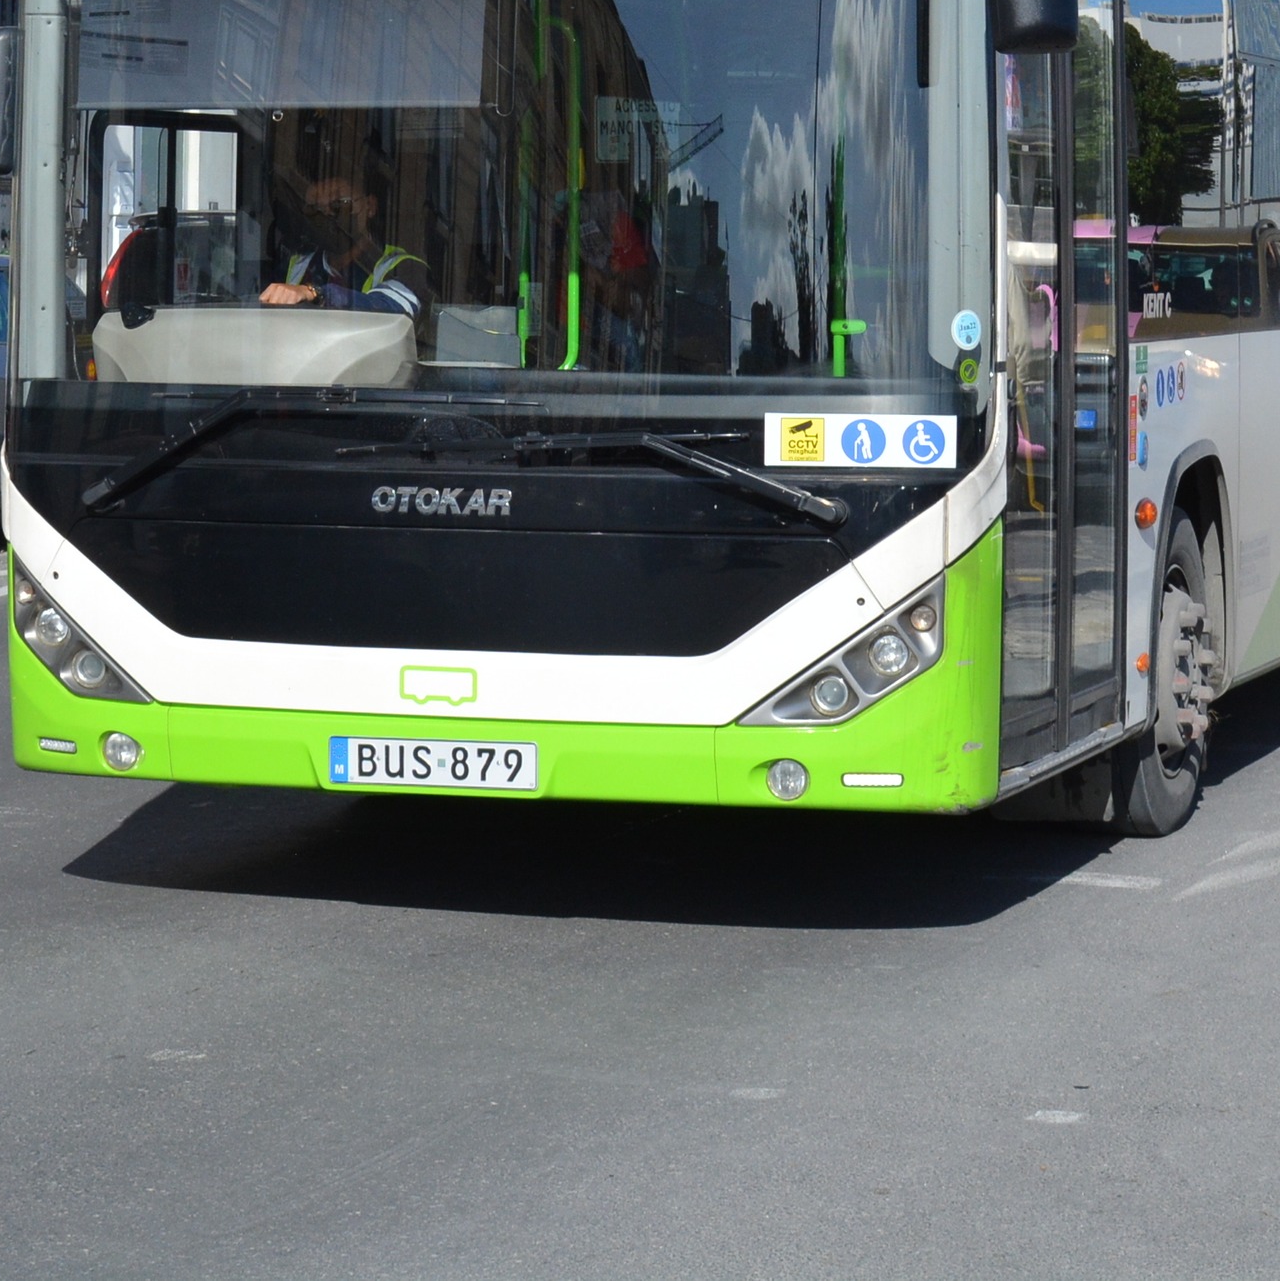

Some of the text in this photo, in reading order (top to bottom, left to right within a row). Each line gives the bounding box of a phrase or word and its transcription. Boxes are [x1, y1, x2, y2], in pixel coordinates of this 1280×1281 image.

[1143, 292, 1165, 319] KENT
[788, 439, 818, 449] CCTV
[371, 486, 513, 516] OTOKAR
[357, 743, 523, 783] BUS 879
